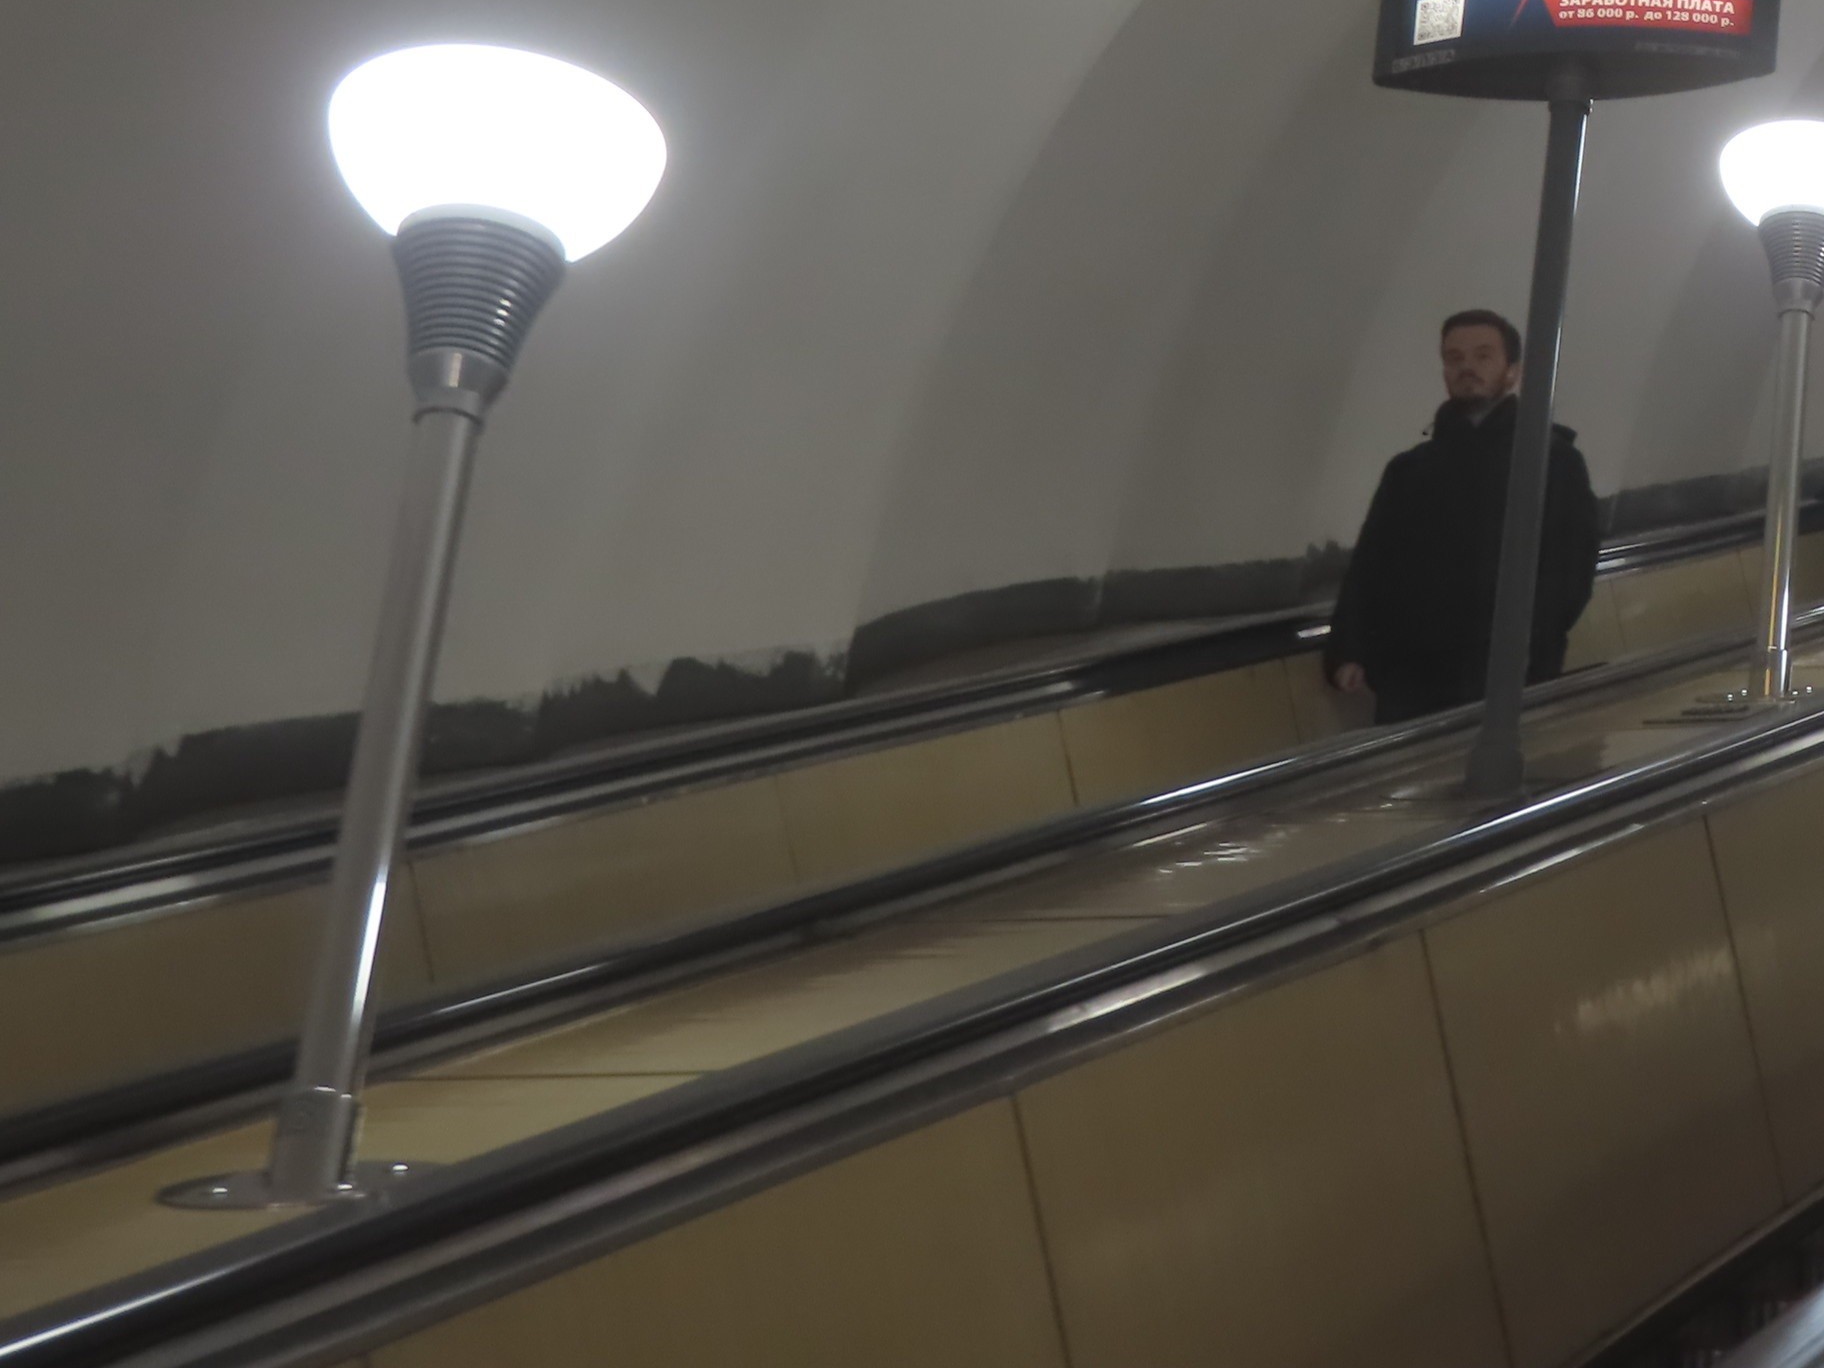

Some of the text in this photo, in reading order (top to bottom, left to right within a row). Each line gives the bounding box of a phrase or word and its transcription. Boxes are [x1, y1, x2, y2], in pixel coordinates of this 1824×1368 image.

[1558, 10, 1575, 19] от
[1597, 8, 1623, 18] 000
[1625, 10, 1639, 21] р.
[1643, 11, 1662, 20] до
[1692, 13, 1718, 24] 000
[1721, 17, 1735, 27] р.
